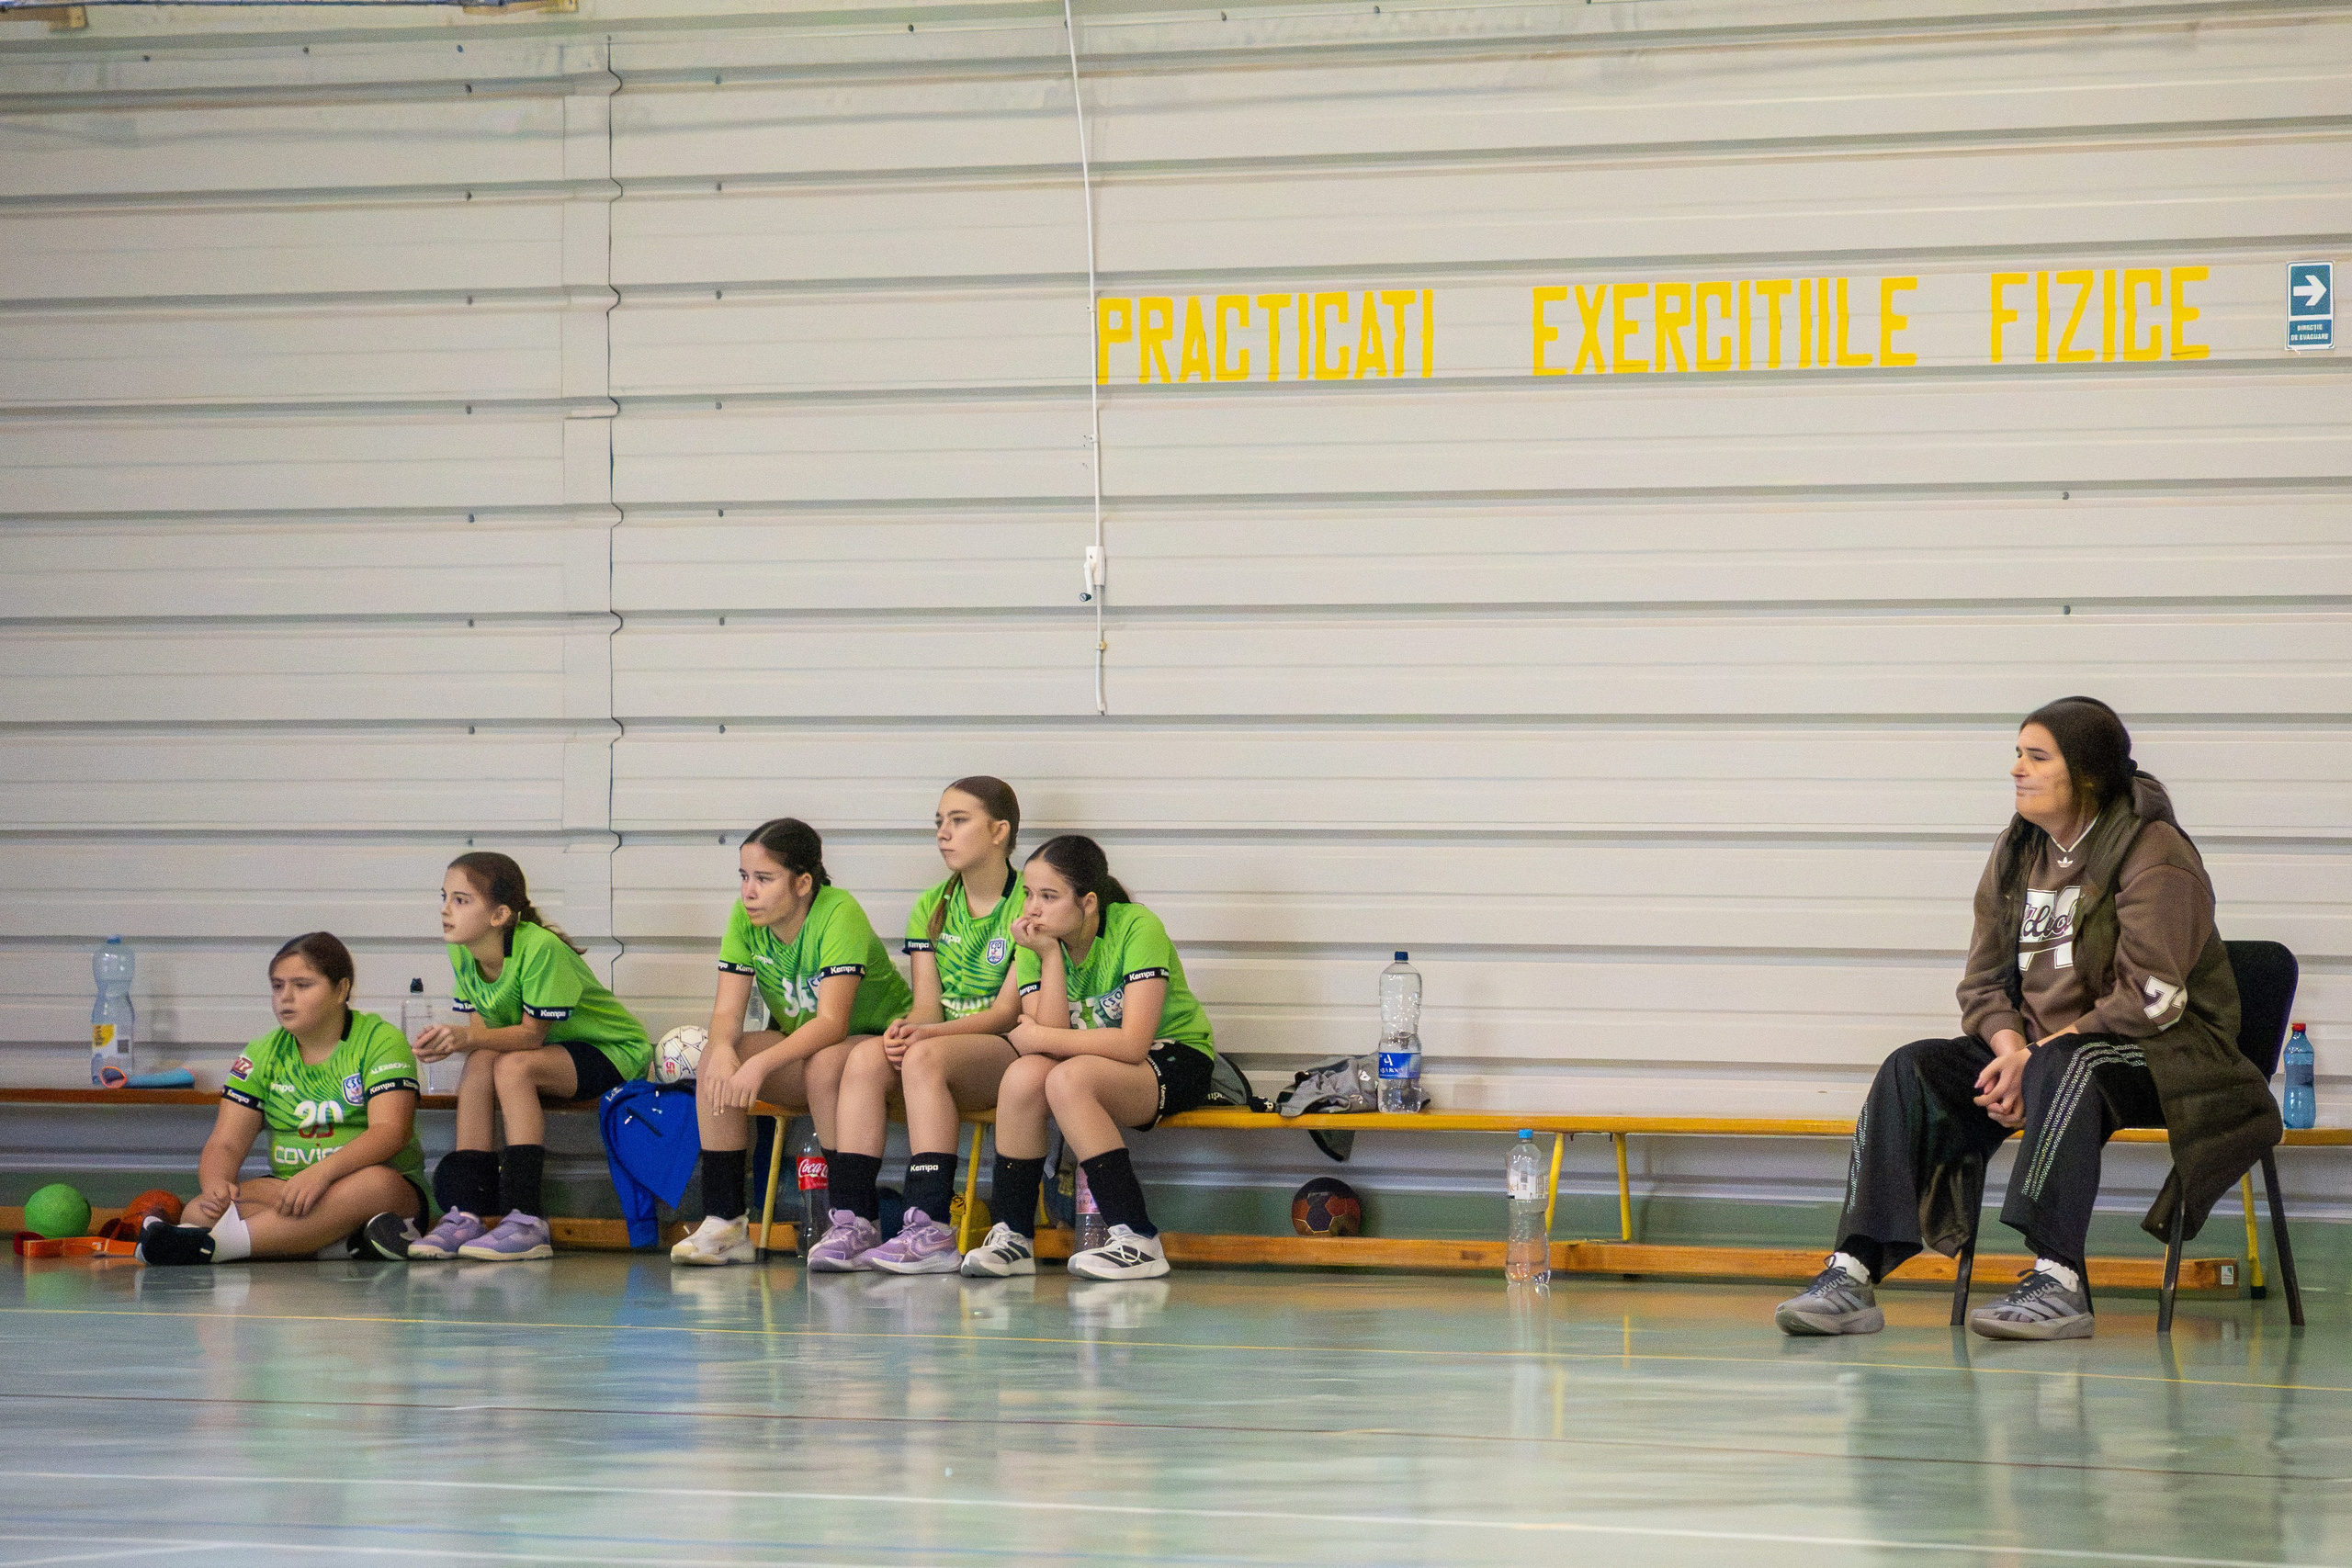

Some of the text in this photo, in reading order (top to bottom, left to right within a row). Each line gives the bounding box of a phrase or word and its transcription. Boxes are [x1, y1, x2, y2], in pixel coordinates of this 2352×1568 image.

[1097, 265, 2210, 385] PRACTICATI EXERCITIILE FIZICE
[831, 965, 856, 974] Kempa
[1129, 970, 1156, 982] Kempa
[540, 1010, 566, 1019] Kempa
[369, 1081, 396, 1095] Kempa
[910, 1164, 939, 1172] Kempa
